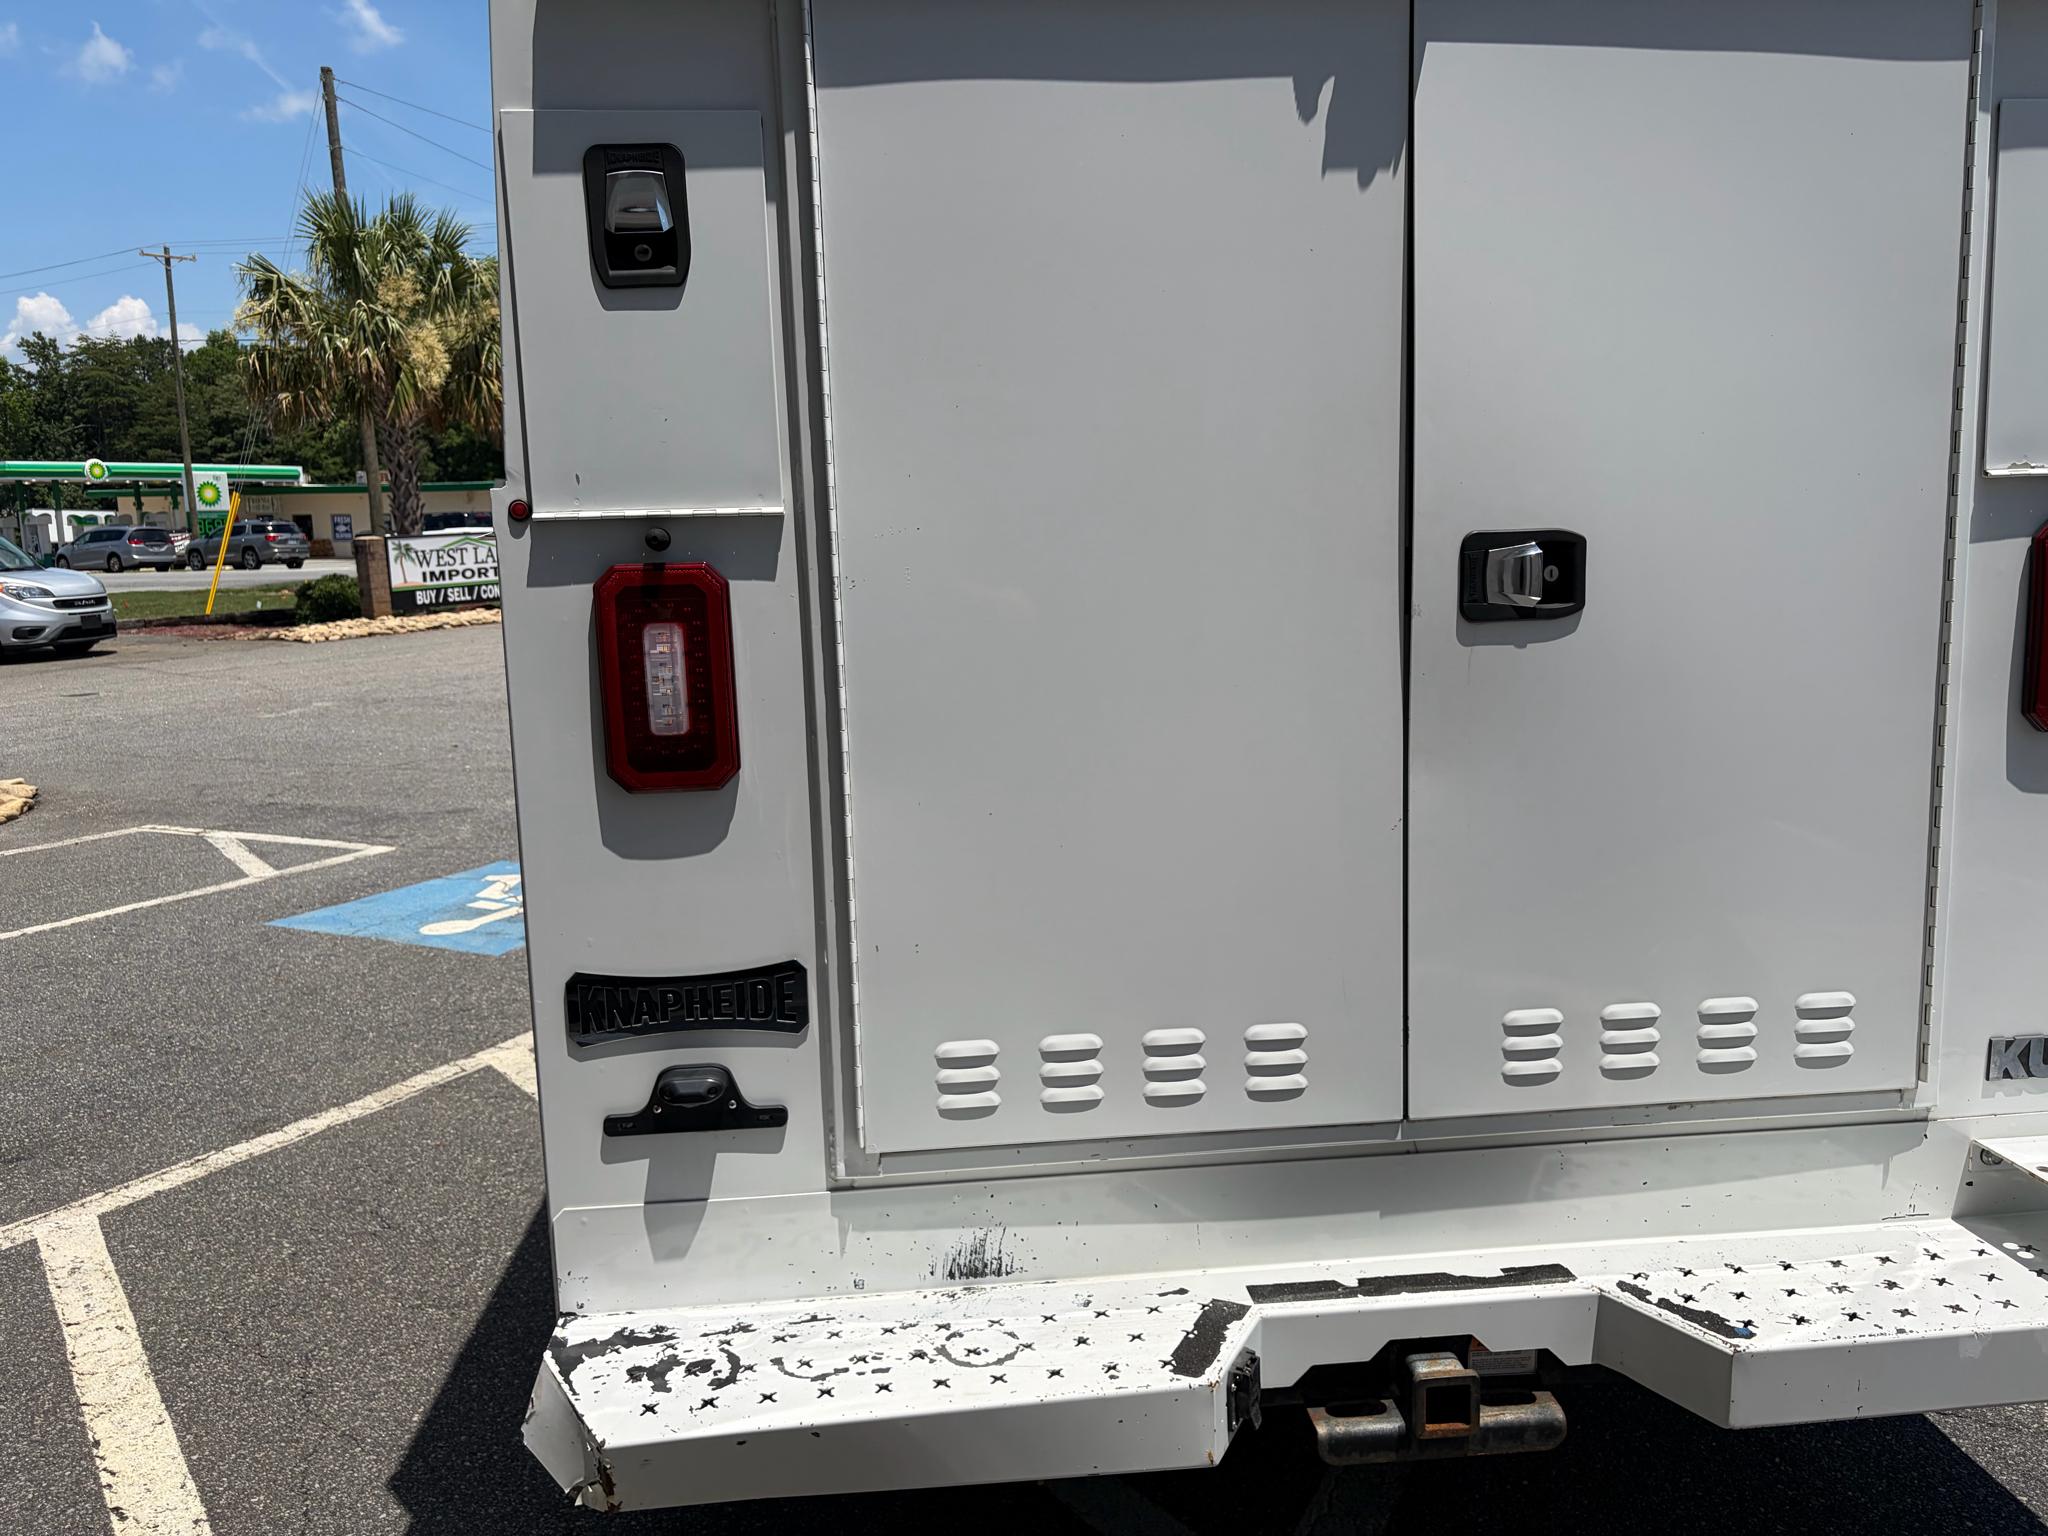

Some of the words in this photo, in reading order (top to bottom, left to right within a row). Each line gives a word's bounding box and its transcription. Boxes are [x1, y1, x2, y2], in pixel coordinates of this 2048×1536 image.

[414, 547, 468, 569] WEST
[473, 546, 497, 565] LA
[422, 566, 499, 583] IMPORT
[415, 589, 436, 605] BUY
[447, 586, 471, 602] SELL
[577, 971, 799, 1035] KNAPHEIDE
